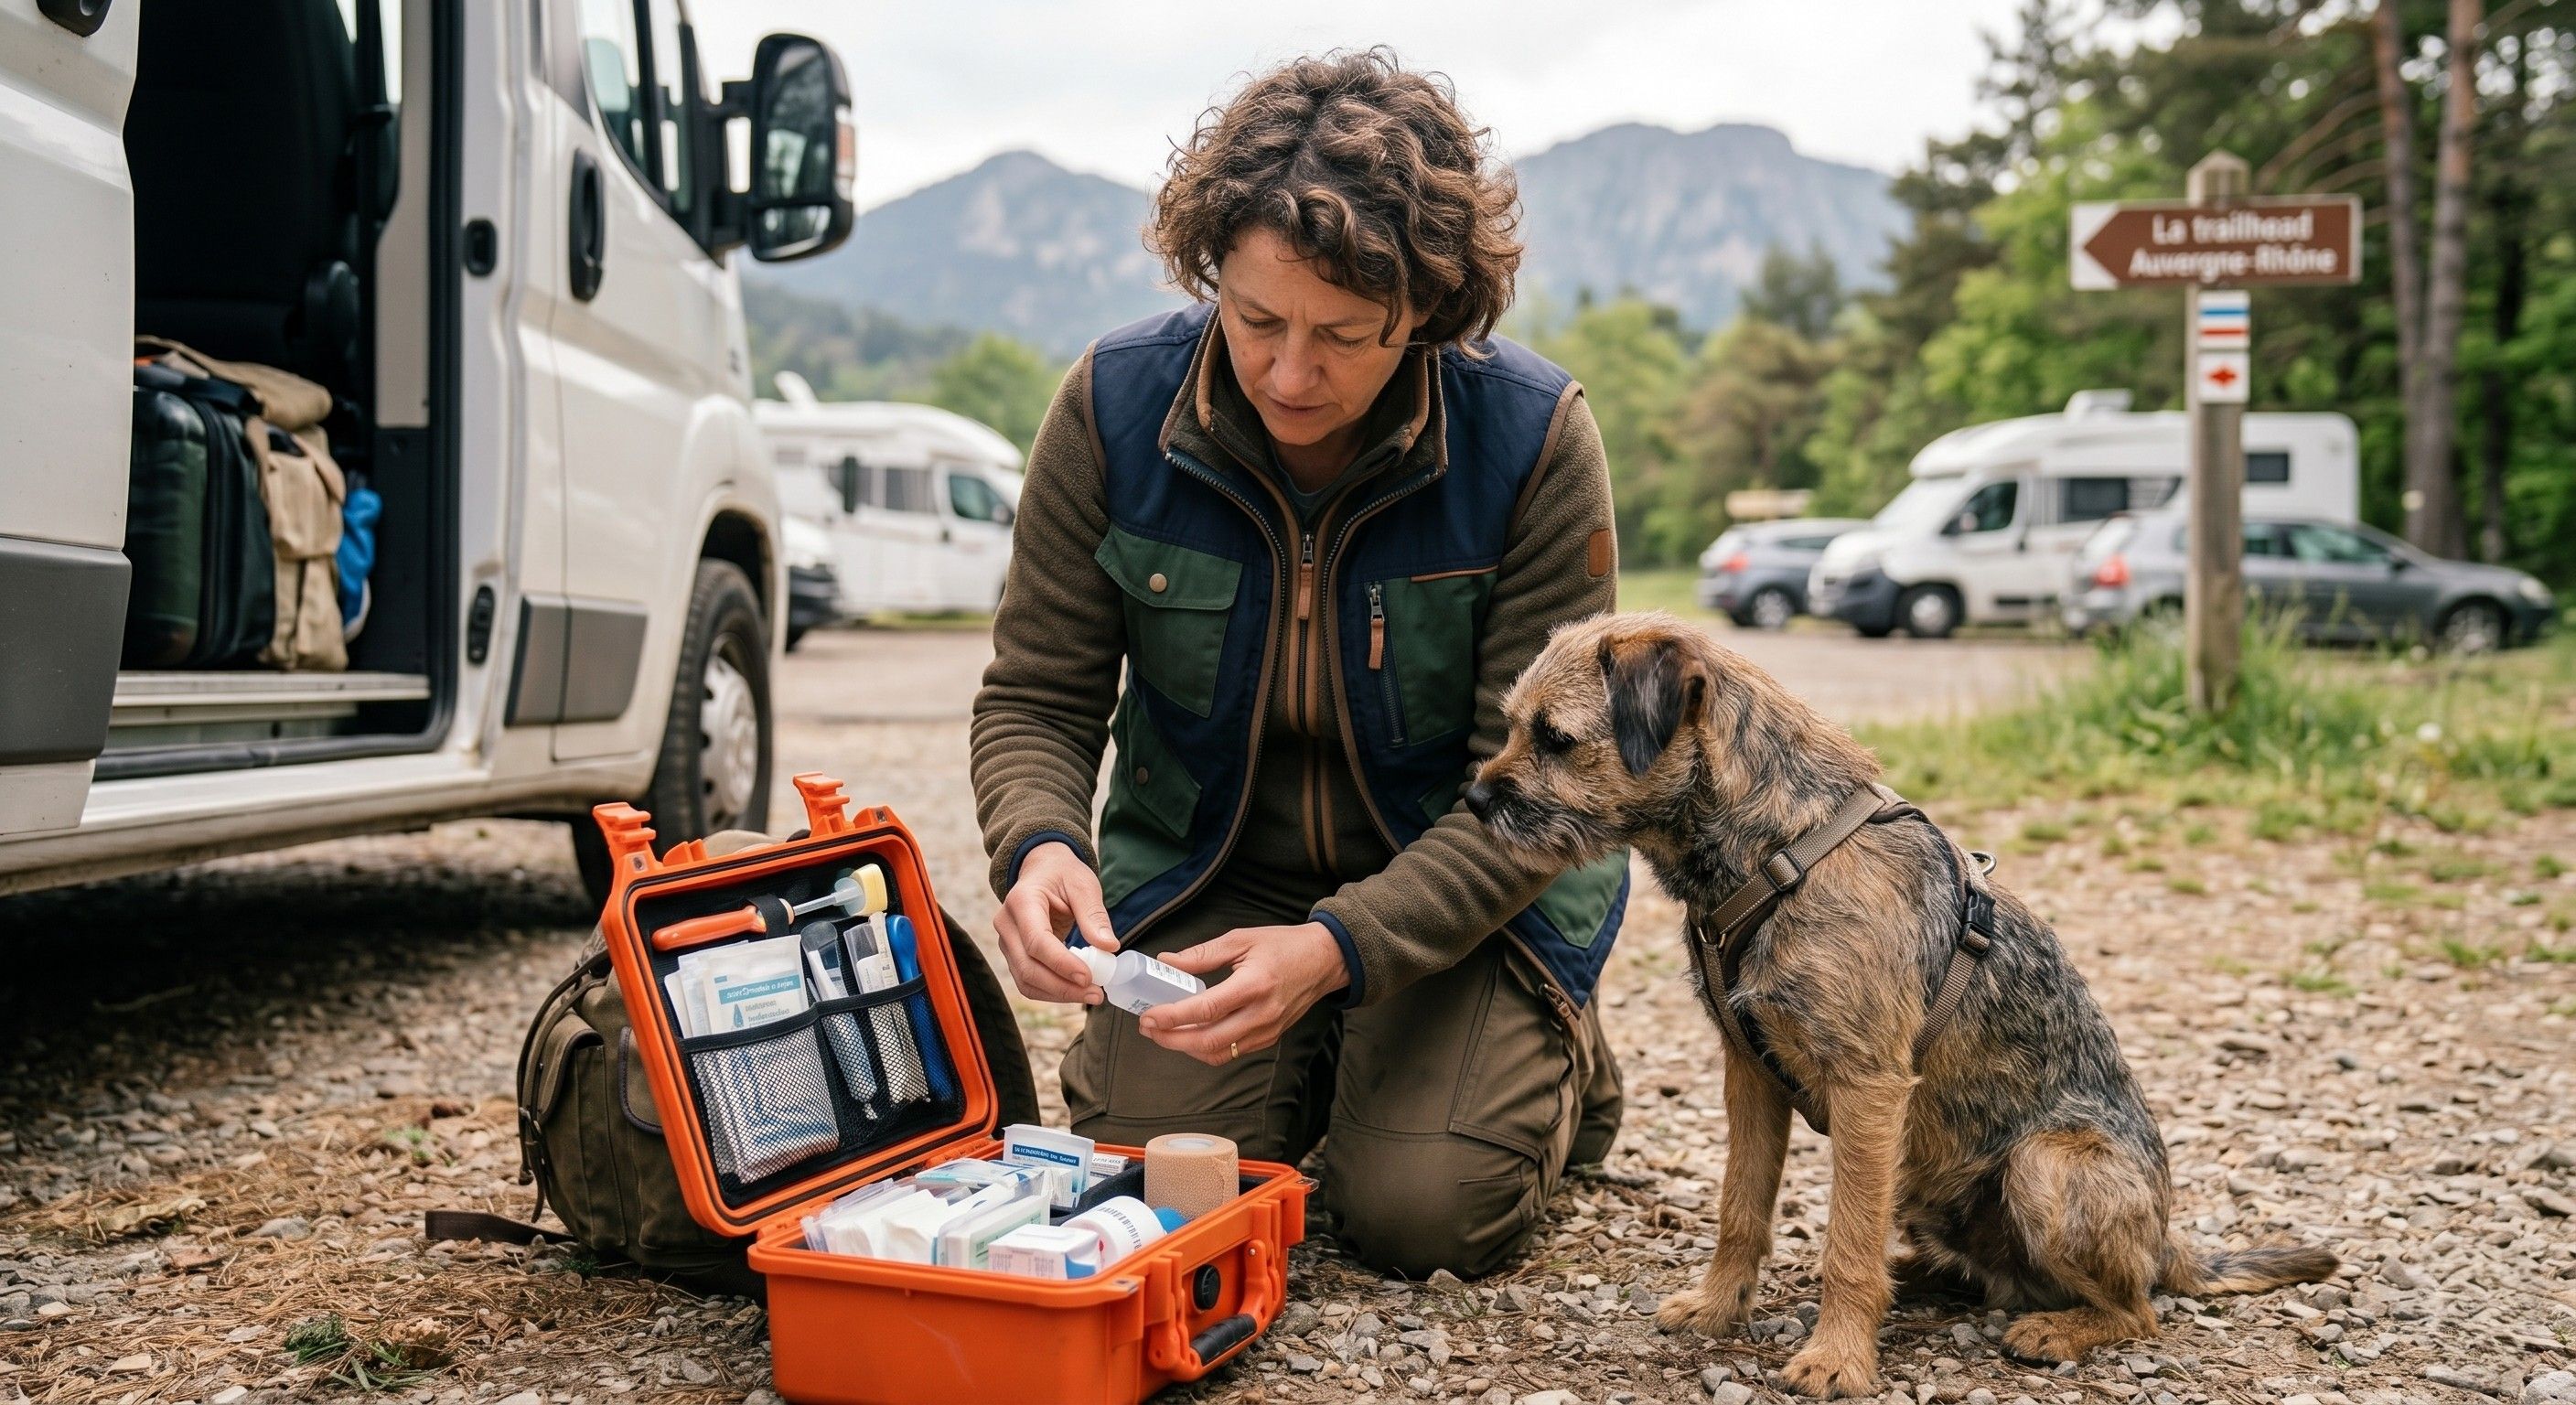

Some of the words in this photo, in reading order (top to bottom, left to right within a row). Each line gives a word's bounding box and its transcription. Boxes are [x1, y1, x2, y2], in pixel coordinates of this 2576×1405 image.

[2152, 215, 2187, 244] La
[2193, 209, 2313, 242] trailhead
[2130, 244, 2336, 283] Auvergne-Rhône
